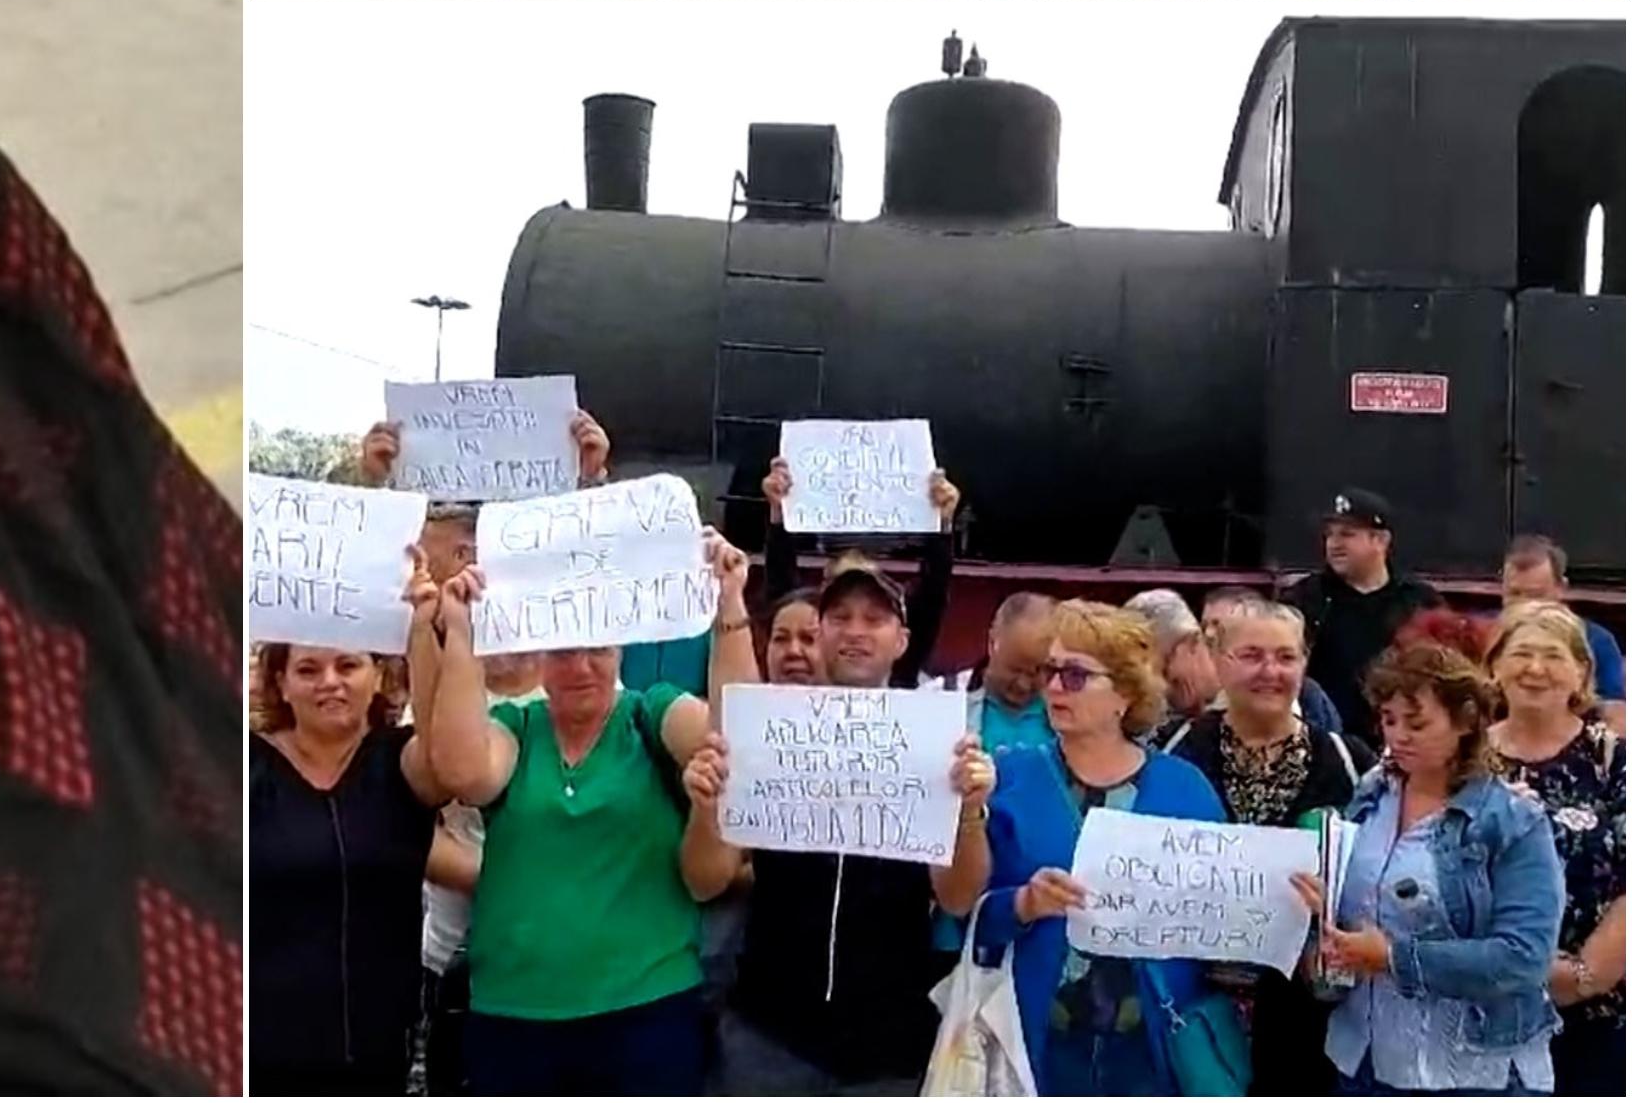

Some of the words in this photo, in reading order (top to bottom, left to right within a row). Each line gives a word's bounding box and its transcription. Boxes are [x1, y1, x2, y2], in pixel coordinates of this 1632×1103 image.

[443, 384, 517, 407] VREM
[457, 438, 481, 456] IN
[249, 486, 365, 532] VREM
[1161, 826, 1242, 859] AVEM
[1148, 900, 1225, 919] AVEM
